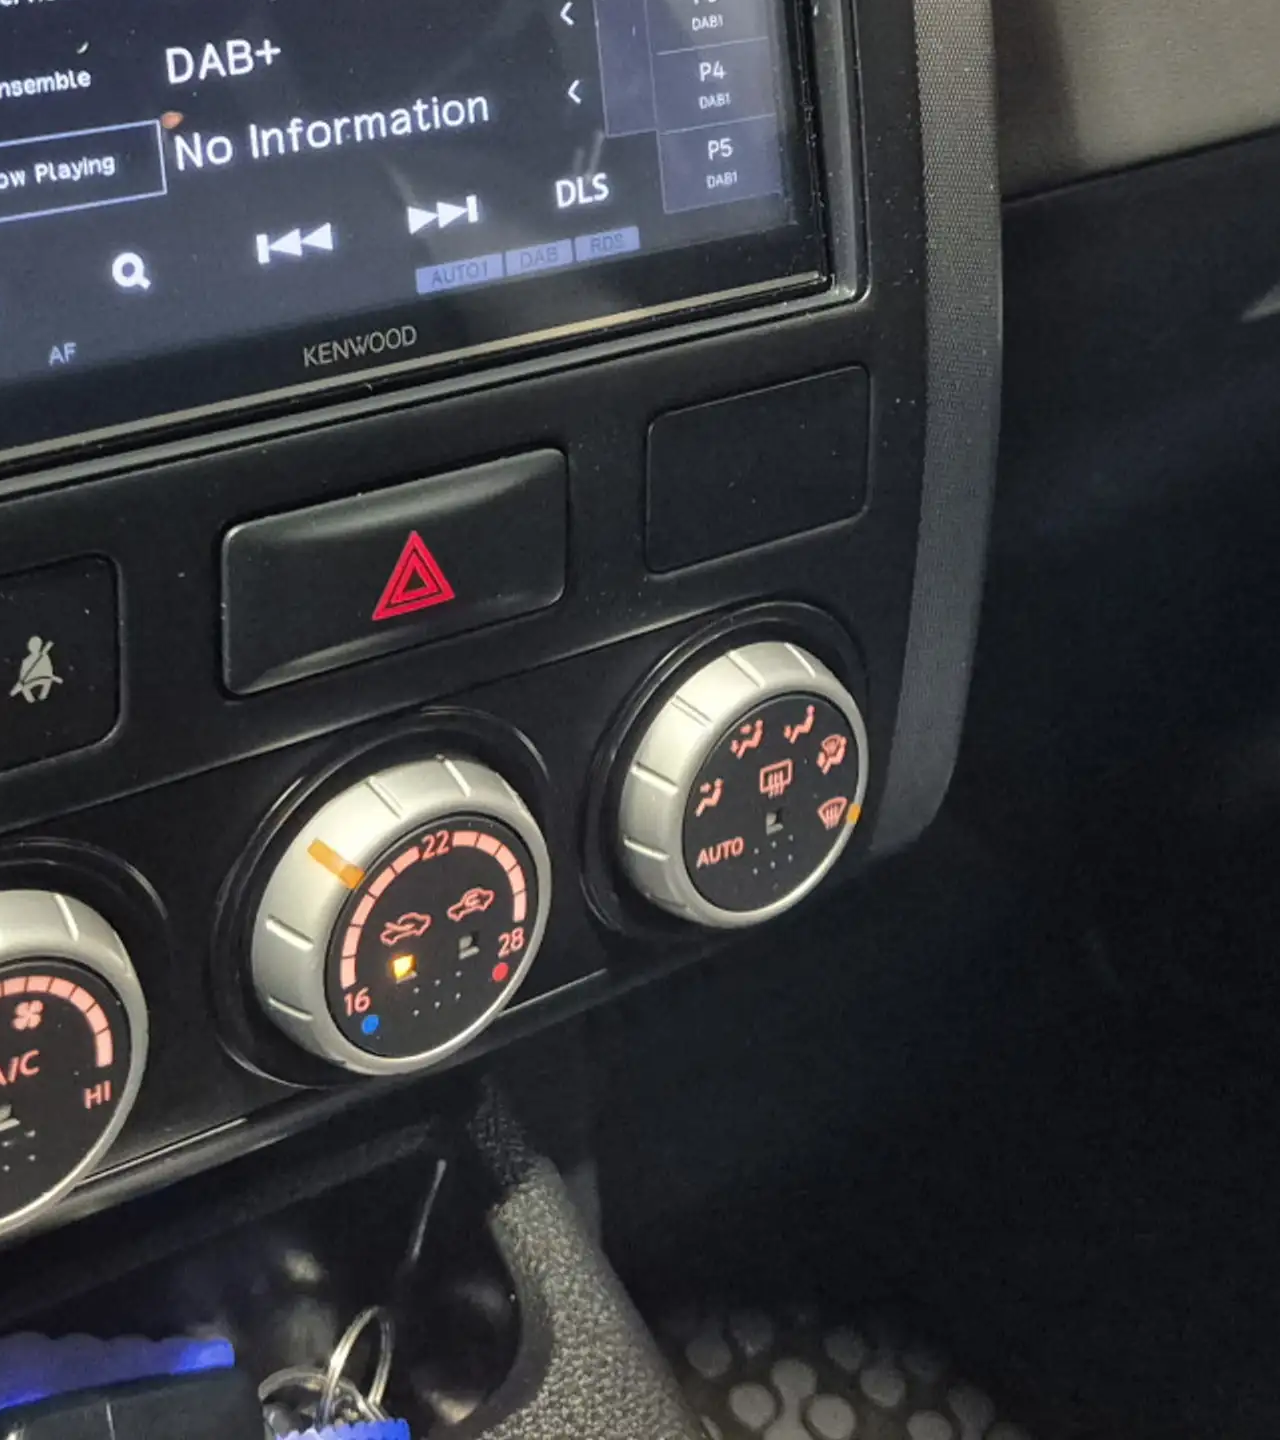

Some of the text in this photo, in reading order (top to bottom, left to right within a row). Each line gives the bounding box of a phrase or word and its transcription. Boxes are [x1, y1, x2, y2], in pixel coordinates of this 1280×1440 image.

[691, 13, 724, 31] DAB1
[166, 38, 281, 85] DAB+
[699, 62, 727, 82] P4
[698, 92, 731, 110] DAB1
[174, 94, 489, 171] No Information
[707, 139, 733, 159] P5
[34, 155, 116, 184] Playing
[706, 170, 739, 189] DAB1
[556, 173, 609, 208] DLS
[520, 245, 558, 268] DAB
[431, 262, 490, 288] AUTO1
[48, 342, 77, 366] AF
[303, 325, 417, 367] KENWOOD
[422, 830, 450, 860] 22
[697, 837, 744, 869] AUTO
[498, 927, 524, 958] 28
[344, 987, 370, 1016] 16
[84, 1080, 111, 1109] HI
